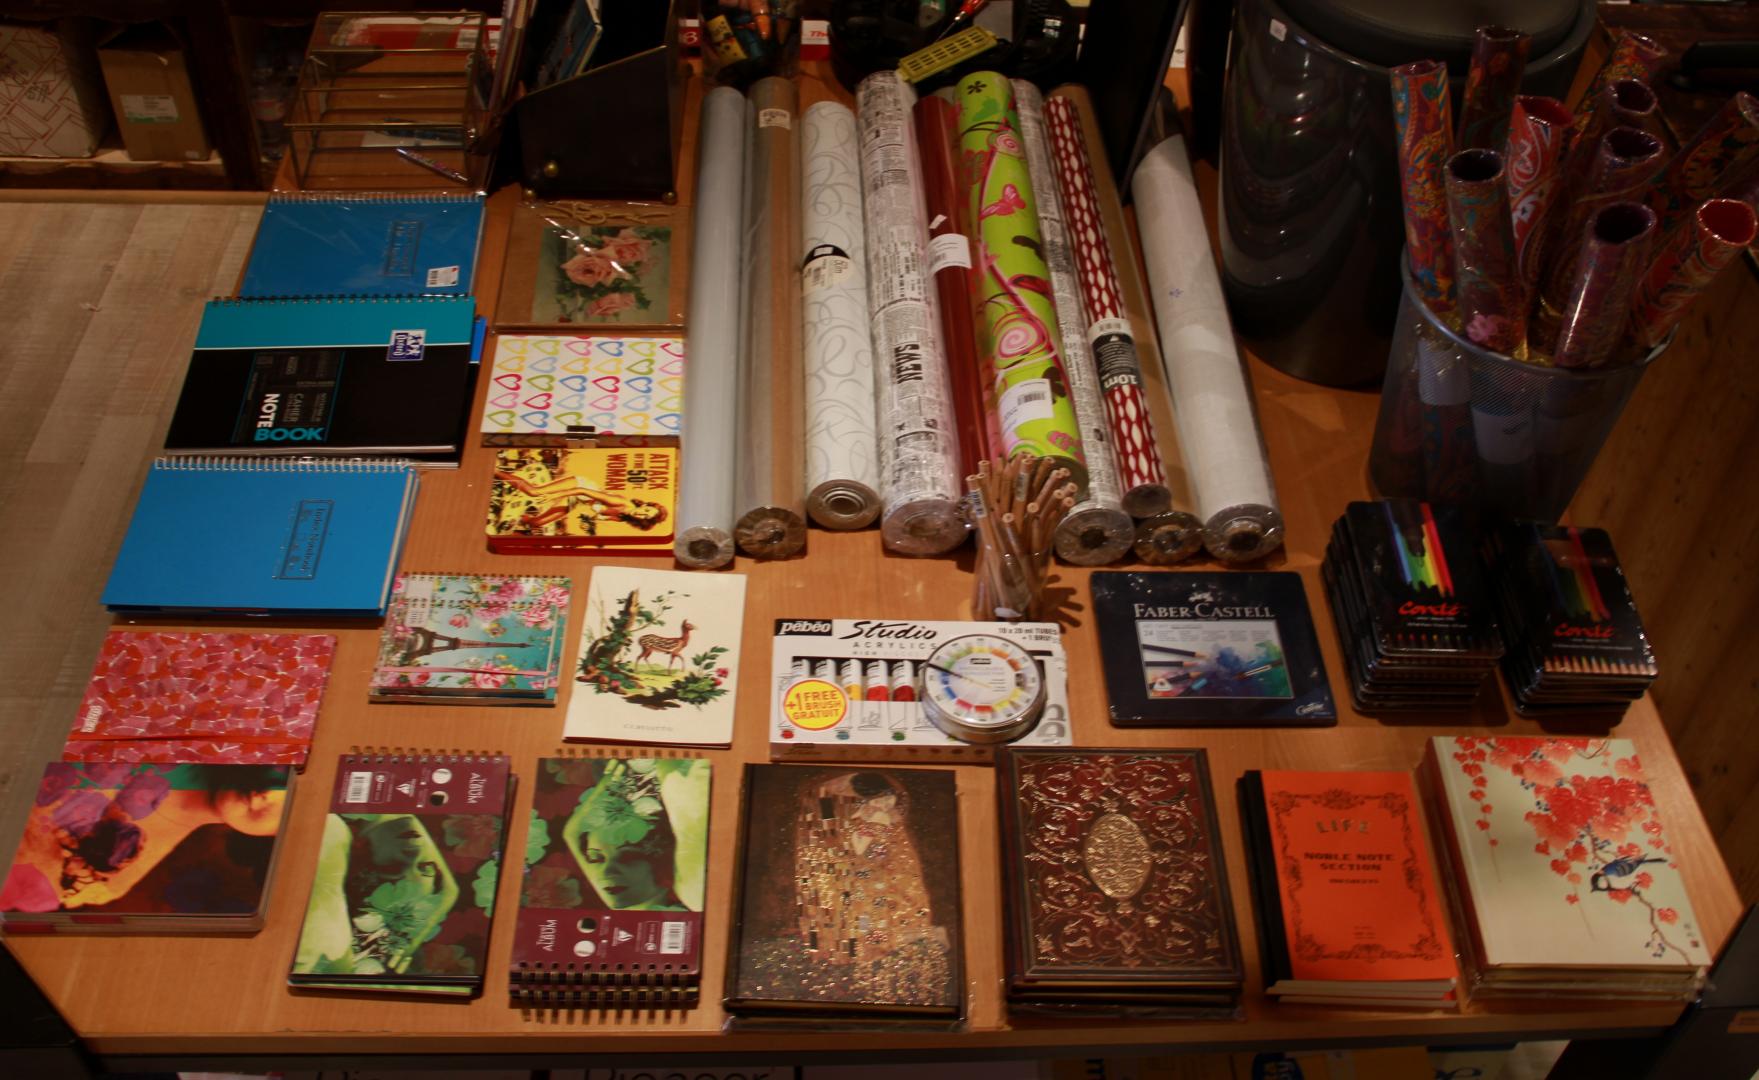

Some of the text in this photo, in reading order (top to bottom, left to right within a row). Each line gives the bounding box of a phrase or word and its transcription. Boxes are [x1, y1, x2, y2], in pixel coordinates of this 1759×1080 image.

[894, 343, 923, 384] NEWS
[1103, 374, 1138, 389] 10m
[257, 393, 281, 428] NOTE
[254, 427, 326, 441] BOOK
[605, 453, 627, 490] WOMAN
[648, 453, 669, 489] ATTACK
[839, 620, 937, 639] Studio
[852, 641, 938, 650] ACRYLICS
[803, 690, 838, 702] FREE
[805, 700, 841, 711] BRUSH
[791, 709, 840, 721] GRATUIT
[465, 772, 481, 804] ALBUM
[1316, 819, 1370, 833] LIFE
[1356, 853, 1394, 861] NOTE
[1320, 863, 1382, 871] SECTION
[542, 919, 558, 952] ALBUM
